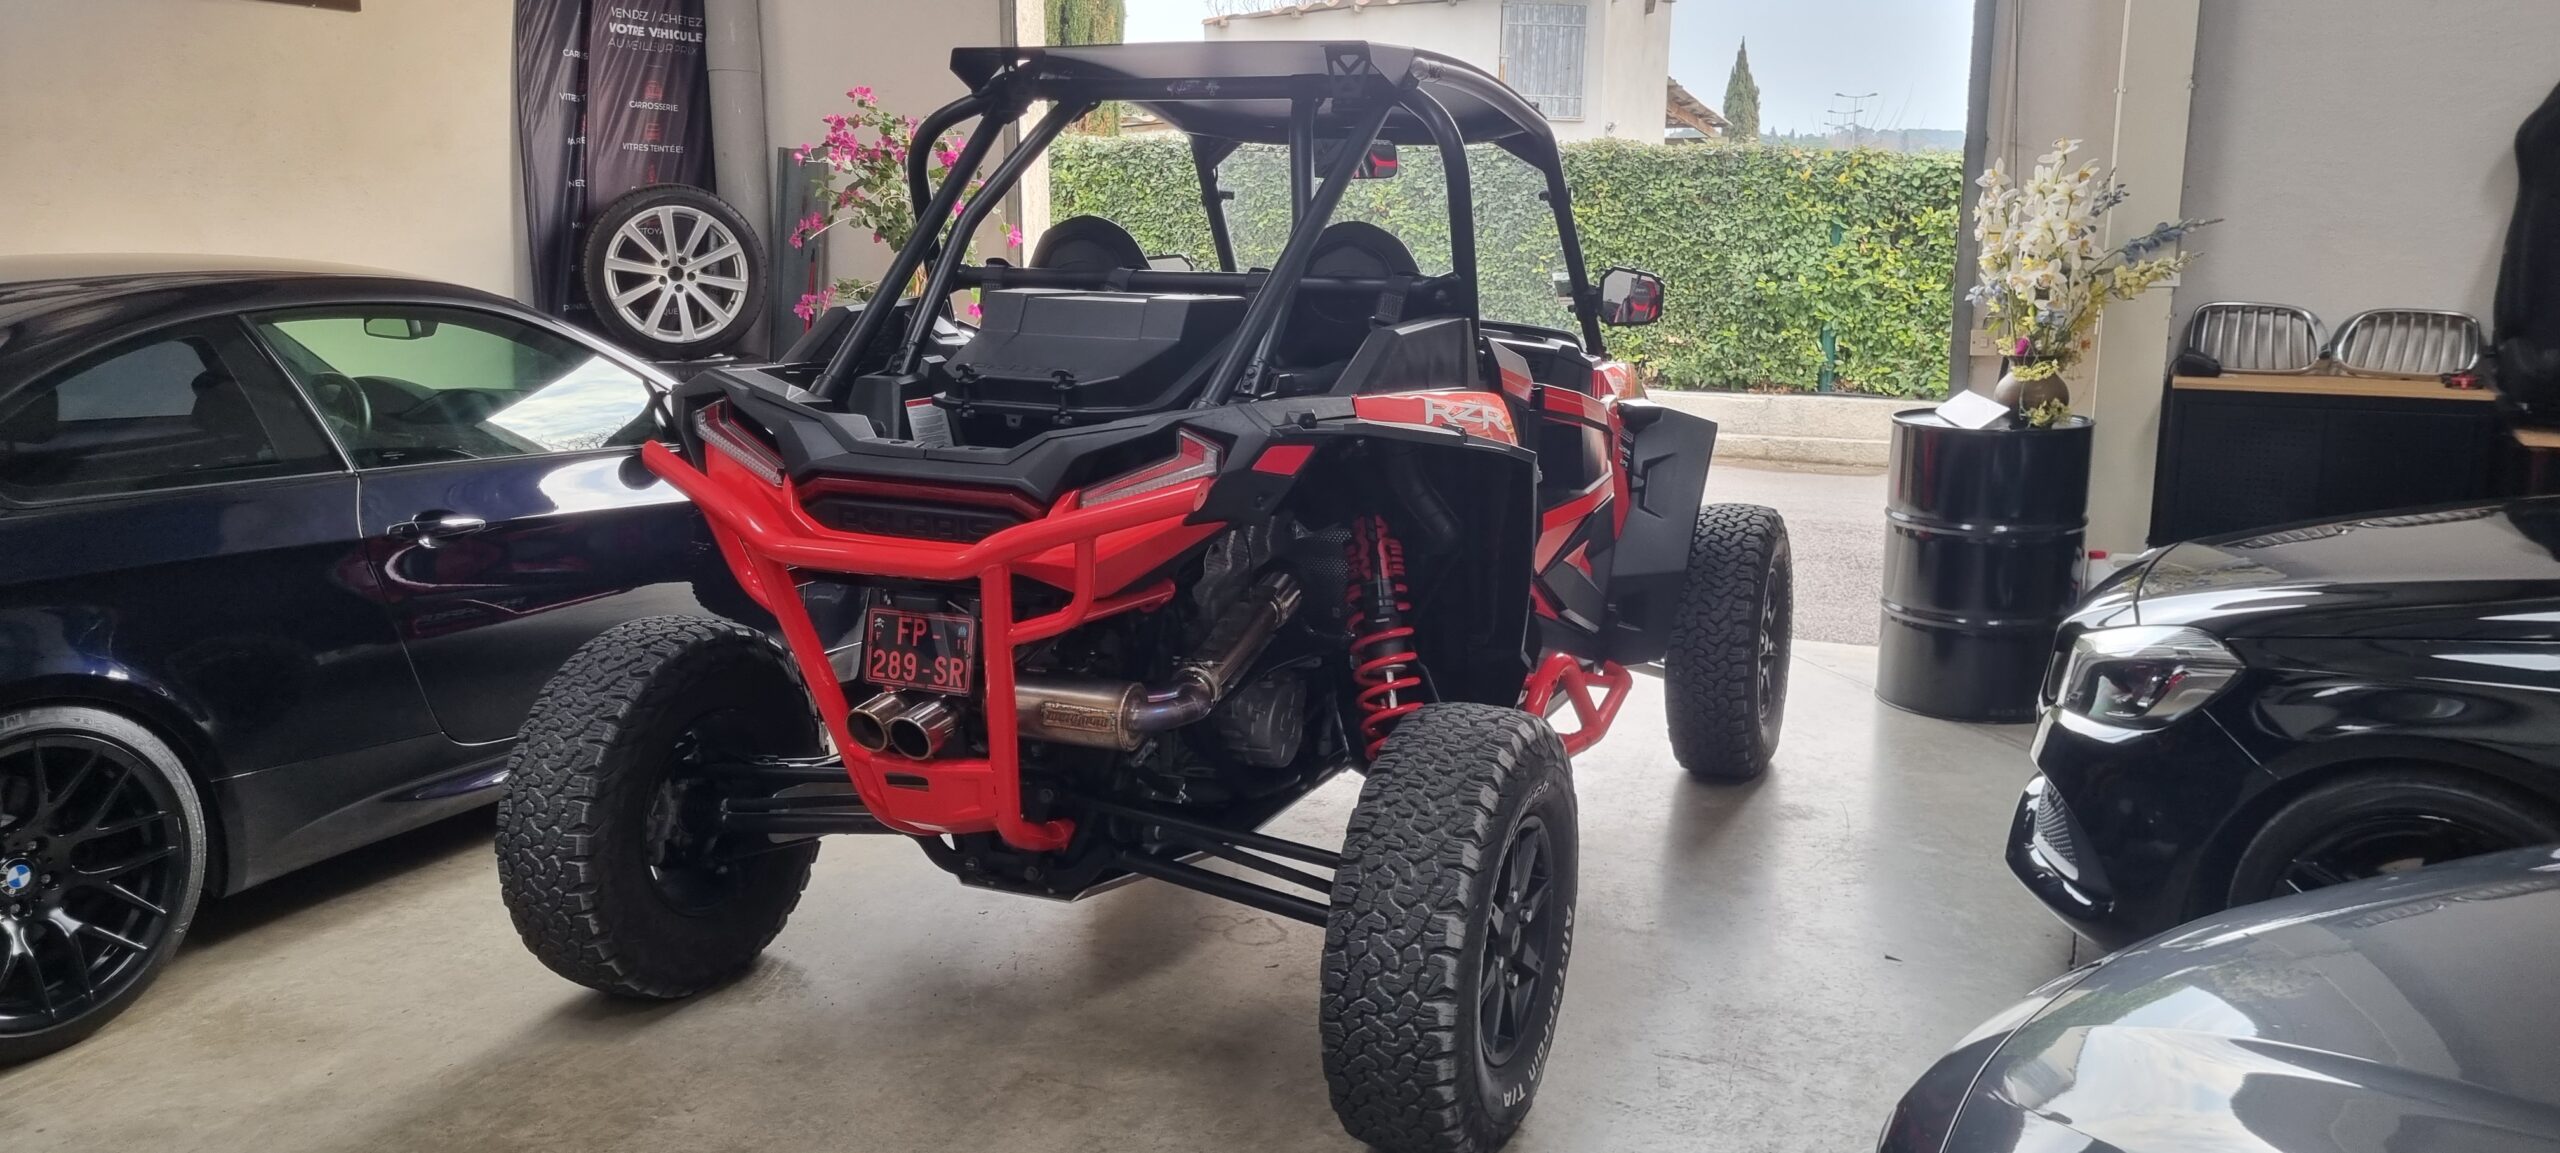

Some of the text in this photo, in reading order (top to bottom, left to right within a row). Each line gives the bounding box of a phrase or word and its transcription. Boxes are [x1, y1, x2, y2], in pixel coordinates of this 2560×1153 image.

[611, 6, 649, 21] VENDEZ
[659, 13, 703, 28] ACHETEZ
[609, 22, 645, 37] VOTRE
[608, 37, 625, 49] AU
[629, 100, 679, 112] CARROSSERIE
[622, 142, 649, 152] VITRES
[1424, 398, 1508, 431] RZR
